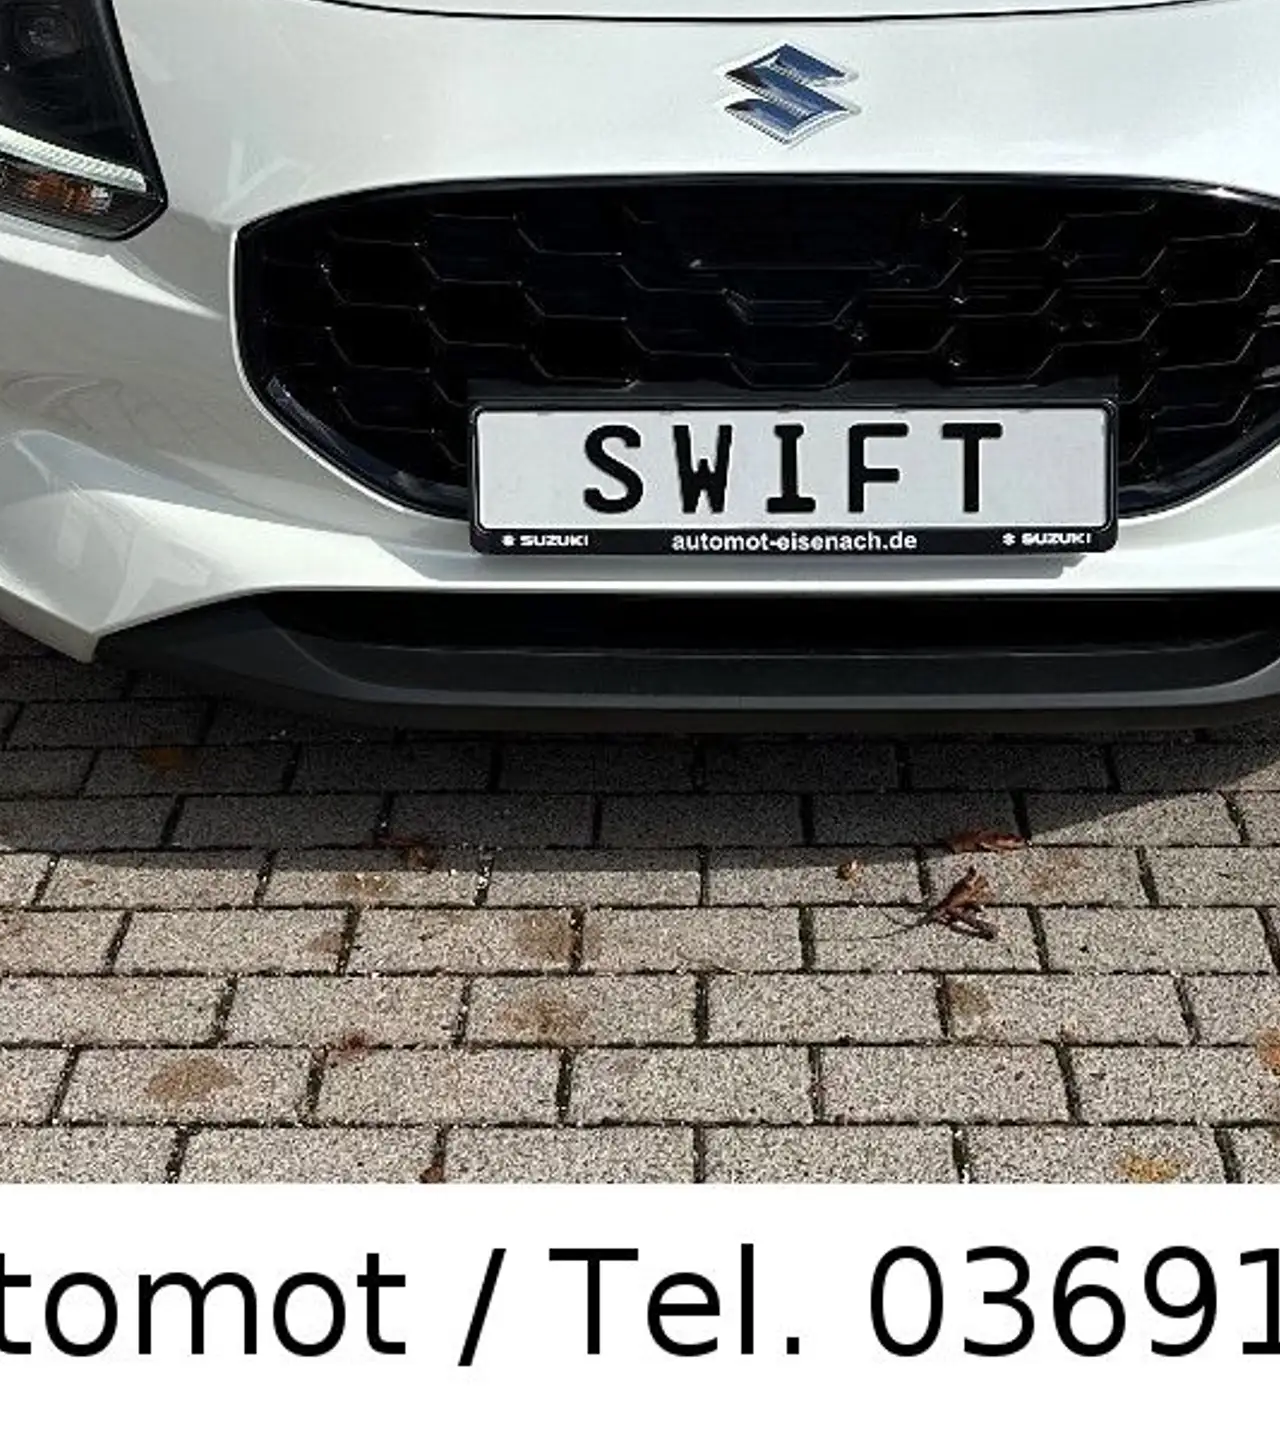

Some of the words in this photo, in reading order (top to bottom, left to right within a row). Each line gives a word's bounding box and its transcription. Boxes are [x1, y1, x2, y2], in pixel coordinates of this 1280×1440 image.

[584, 422, 1003, 514] SWIFT
[520, 534, 589, 547] SUZUKI
[671, 531, 918, 552] automot-eisenach.de
[1021, 532, 1092, 546] SUZUKI
